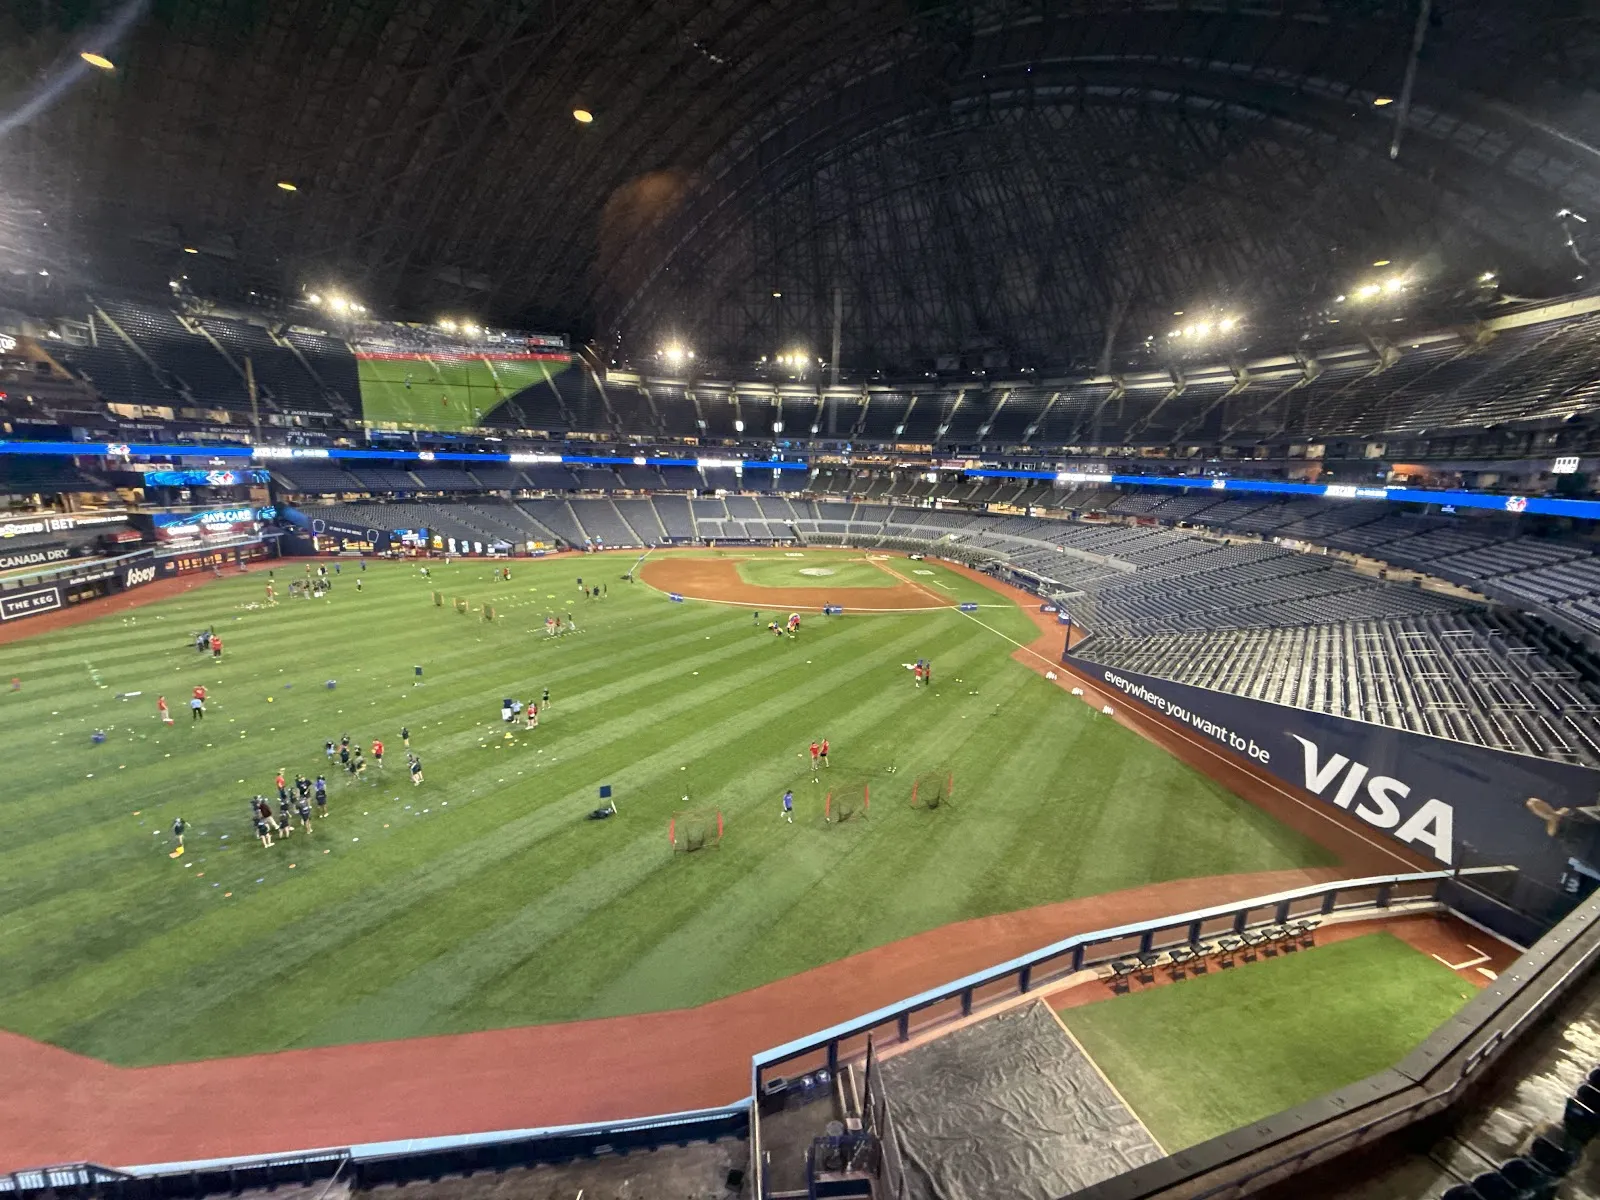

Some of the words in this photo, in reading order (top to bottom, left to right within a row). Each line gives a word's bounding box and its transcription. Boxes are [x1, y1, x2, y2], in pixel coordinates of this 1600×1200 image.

[51, 518, 75, 531] BET
[201, 511, 226, 524] JAYS
[0, 552, 46, 568] CANADA
[47, 548, 69, 560] DRY
[126, 565, 156, 587] Sobeys
[7, 601, 30, 612] THE
[32, 595, 54, 607] KEG
[1104, 670, 1166, 710] everywhere
[1166, 701, 1190, 723] you
[1192, 713, 1228, 743] want
[1229, 731, 1247, 751] to
[1249, 740, 1270, 764] be
[1292, 733, 1454, 866] VISA
